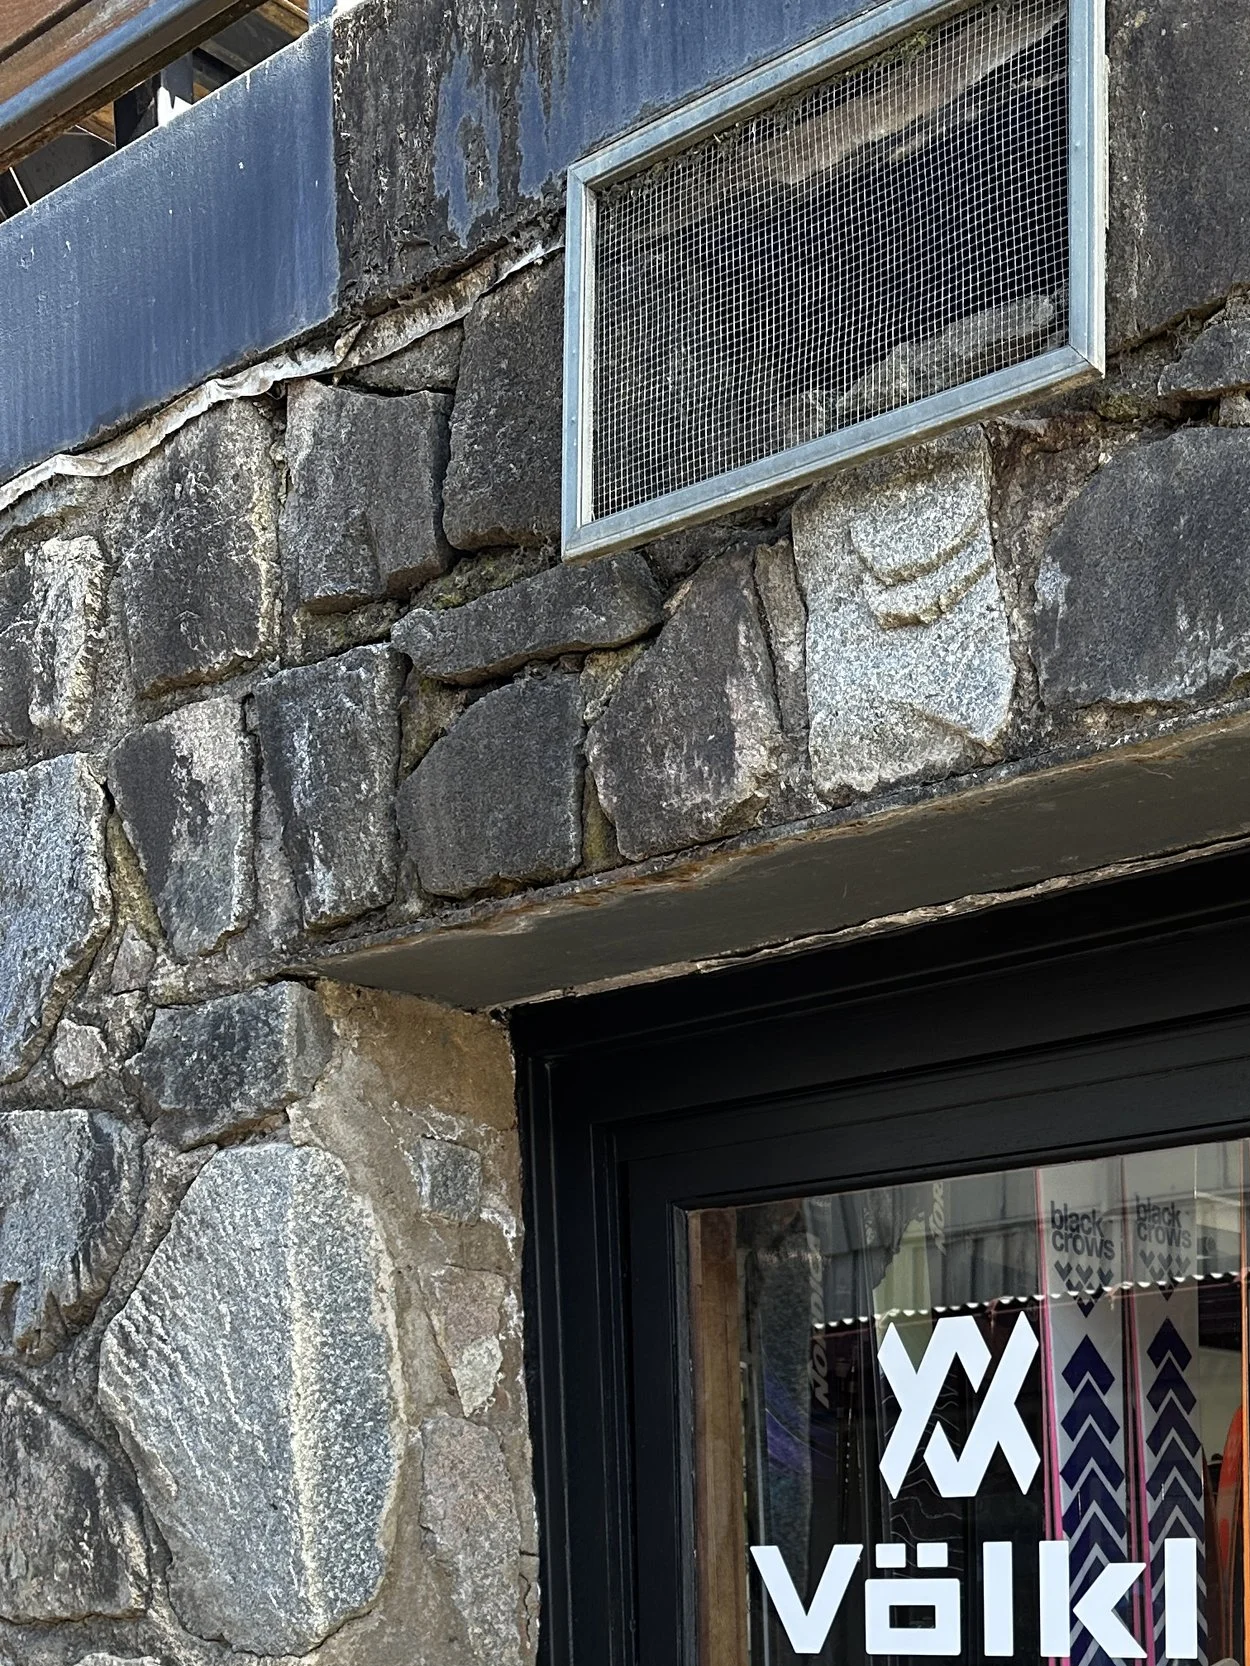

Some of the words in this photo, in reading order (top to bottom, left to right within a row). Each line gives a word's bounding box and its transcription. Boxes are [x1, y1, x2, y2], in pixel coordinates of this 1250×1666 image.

[1050, 1200, 1104, 1238] black
[1136, 1193, 1182, 1228] black
[1052, 1229, 1115, 1261] crows
[1137, 1219, 1192, 1249] crows
